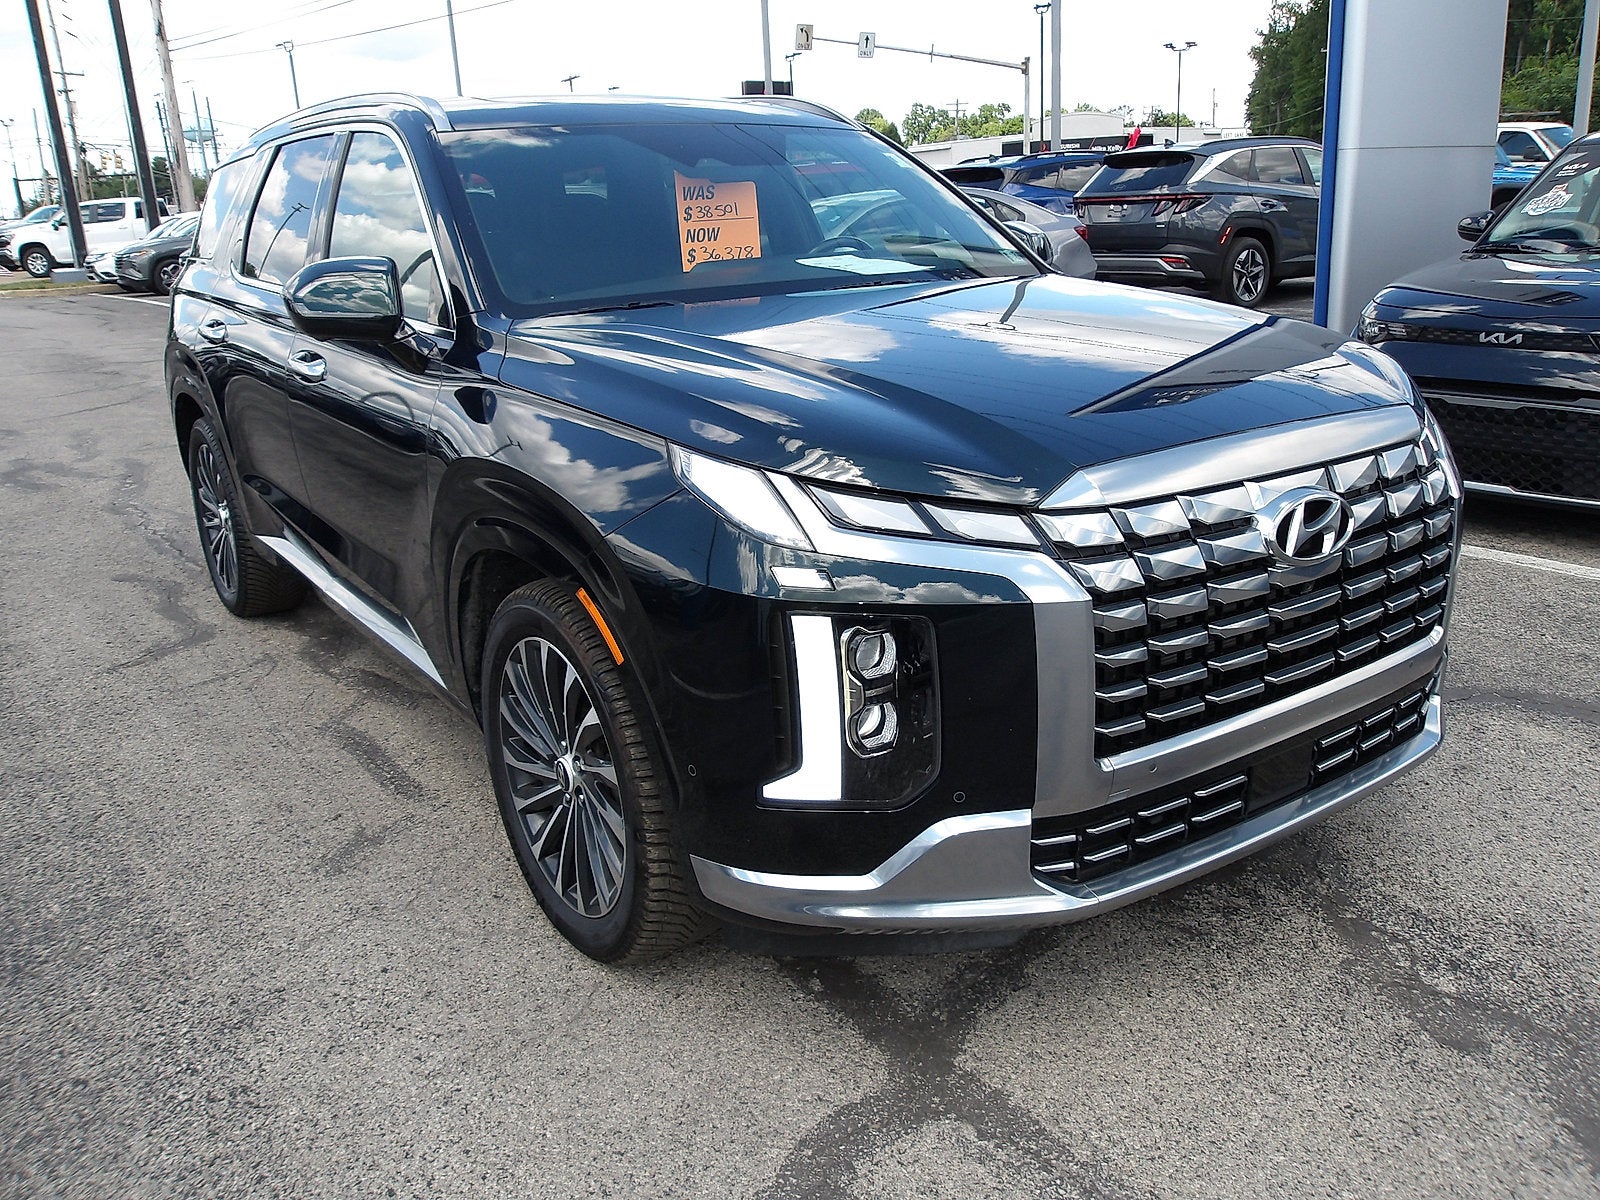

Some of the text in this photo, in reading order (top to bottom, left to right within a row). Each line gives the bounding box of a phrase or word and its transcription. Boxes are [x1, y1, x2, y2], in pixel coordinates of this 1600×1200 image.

[1107, 144, 1123, 152] Kelly
[682, 185, 715, 201] WAS
[686, 227, 720, 243] NOW
